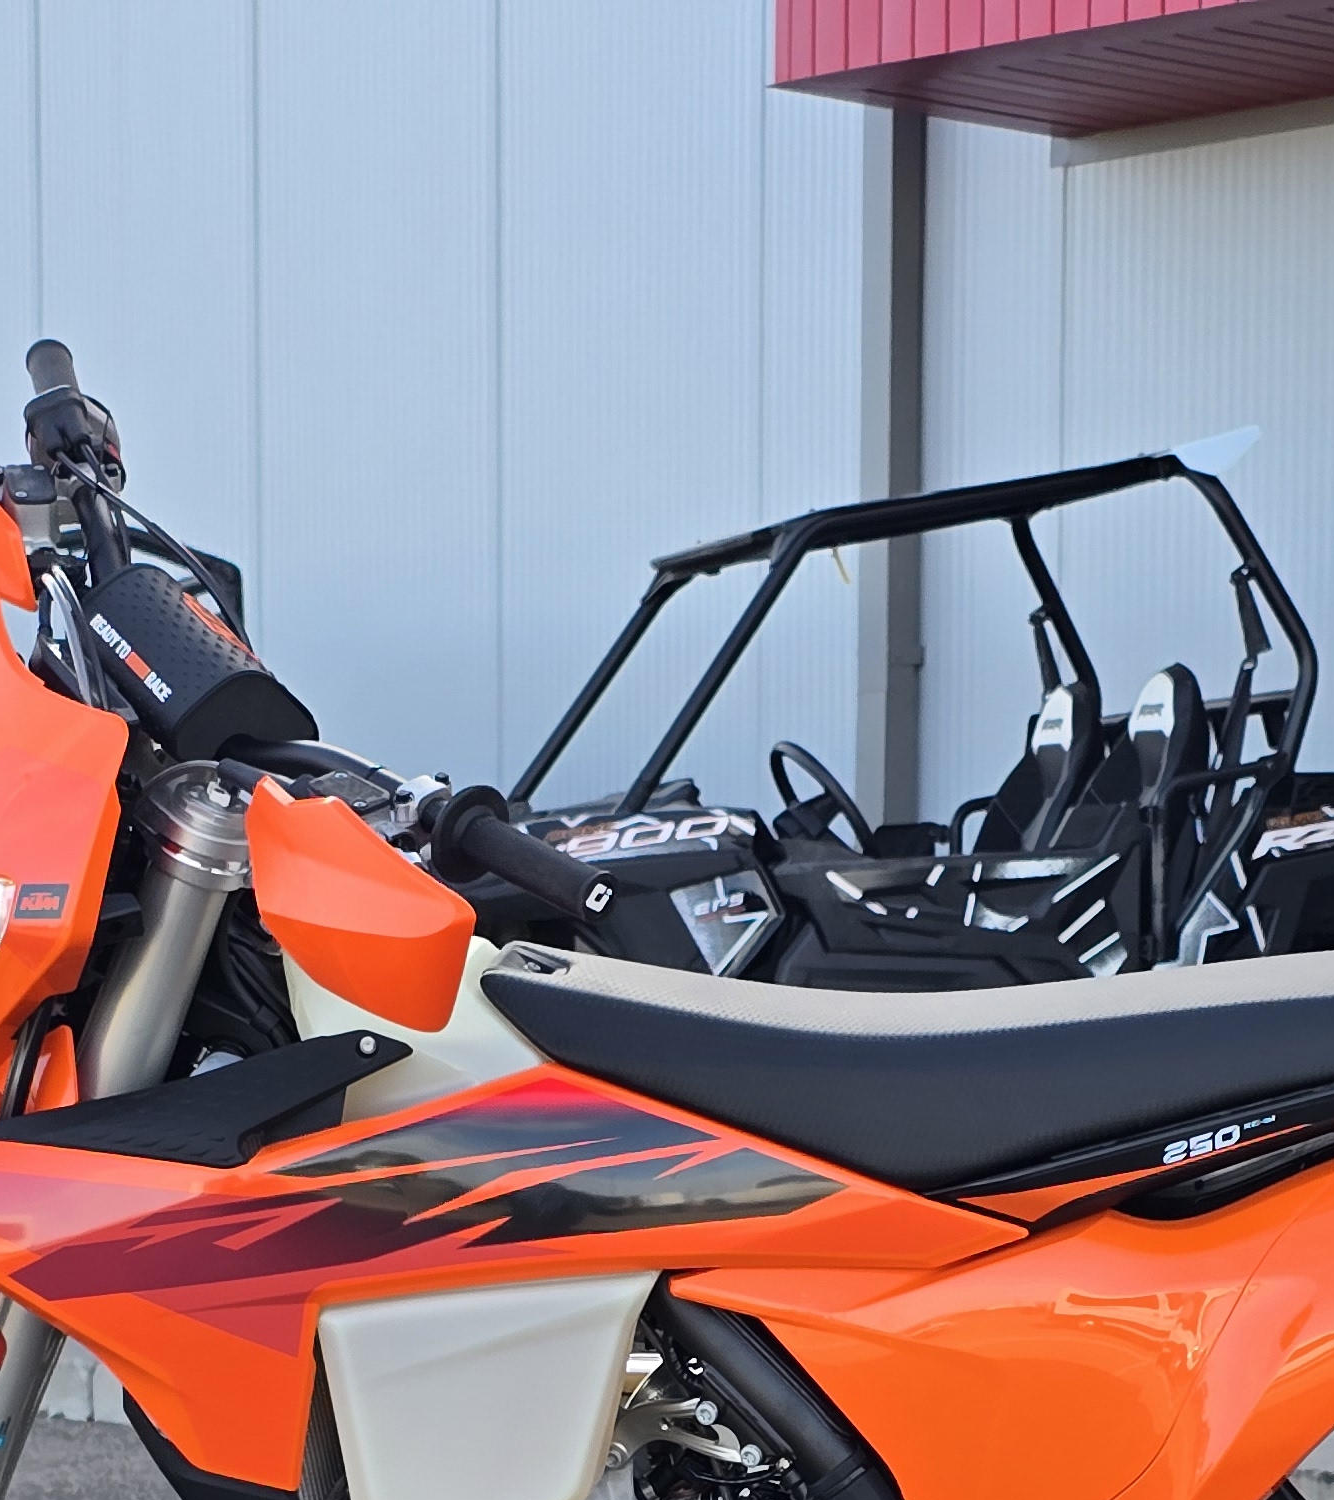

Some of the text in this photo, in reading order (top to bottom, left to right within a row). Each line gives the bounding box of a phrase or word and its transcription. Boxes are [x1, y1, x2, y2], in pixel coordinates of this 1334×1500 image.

[89, 613, 172, 703] READY TO RACE
[19, 891, 61, 911] KTM
[1163, 1124, 1241, 1165] 250
